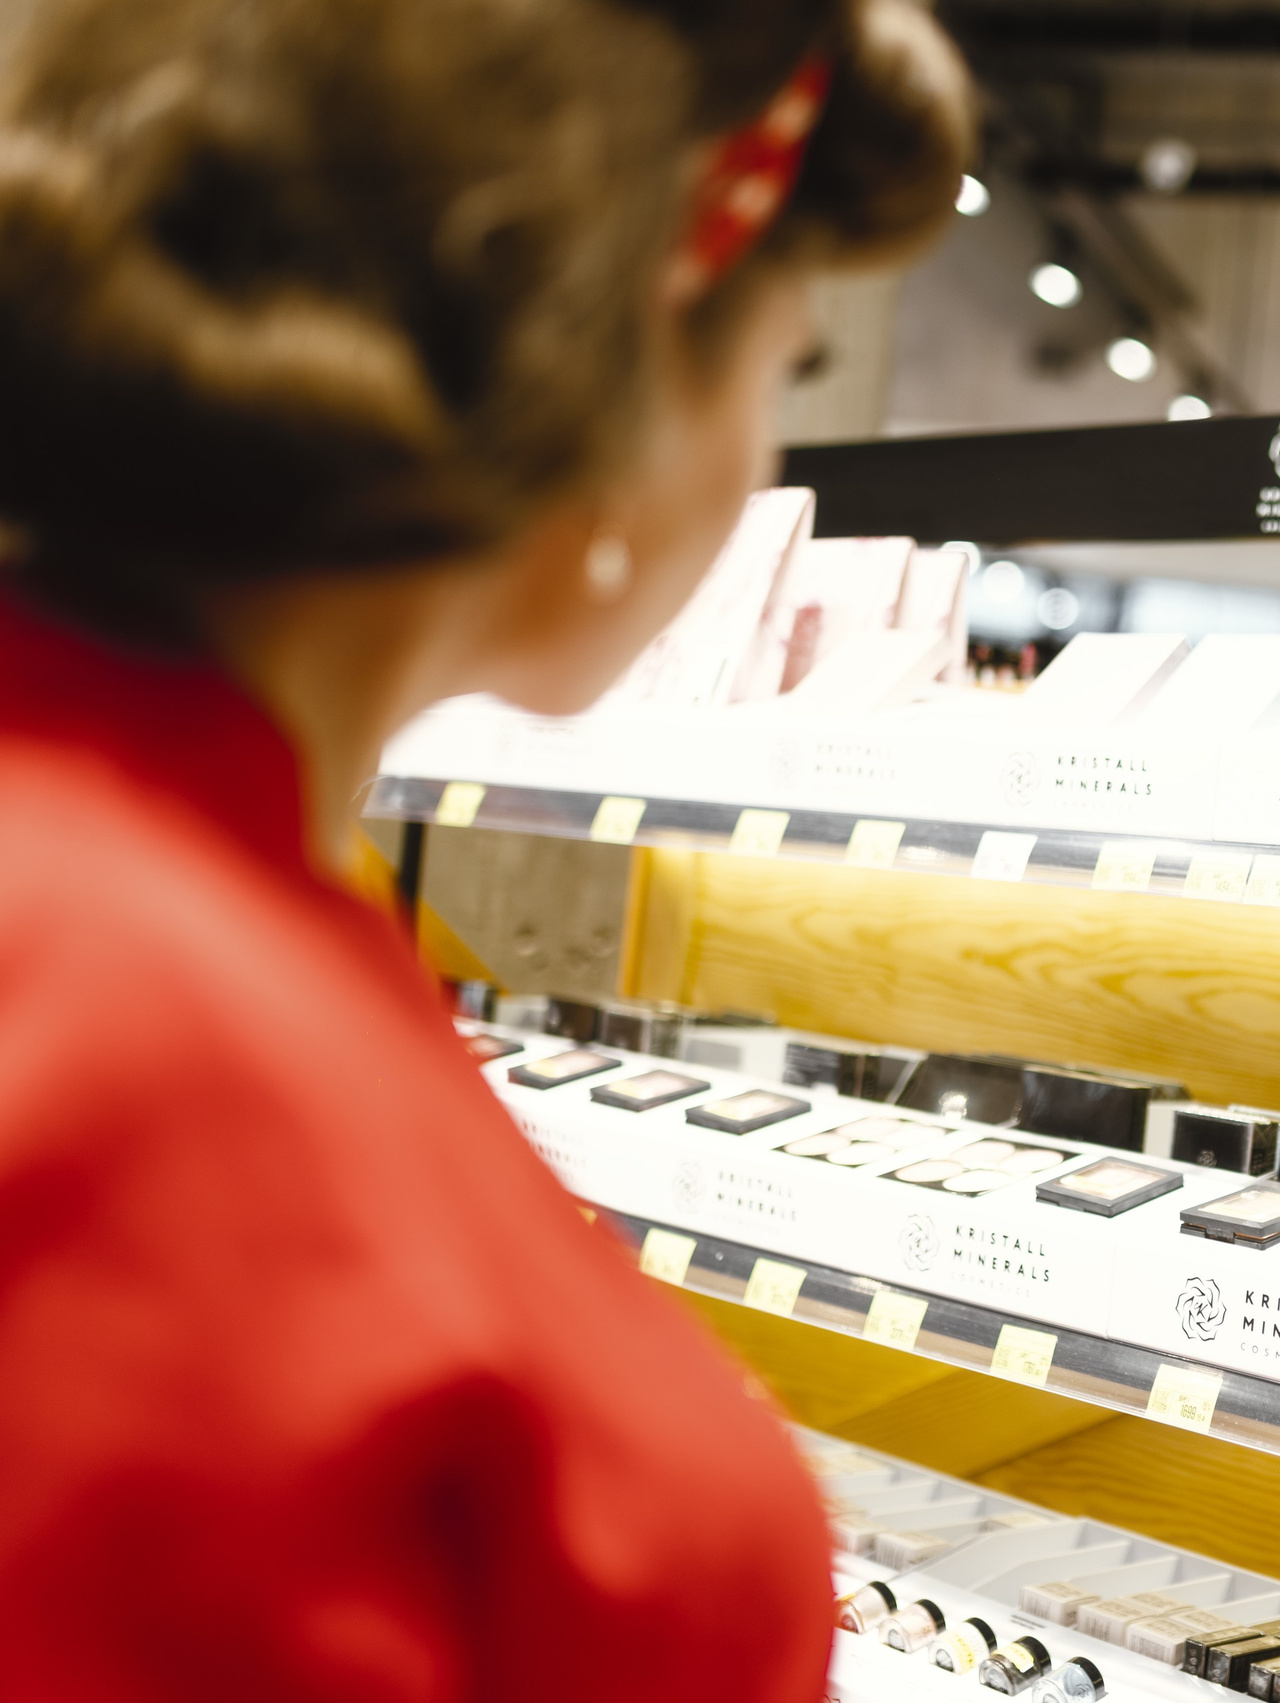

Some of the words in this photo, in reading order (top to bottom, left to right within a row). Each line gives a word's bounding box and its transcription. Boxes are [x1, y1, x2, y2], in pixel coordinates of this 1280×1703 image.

[1057, 755, 1147, 773] KRISTALL
[1056, 779, 1152, 796] MINERALS
[955, 1224, 1046, 1257] KRISTALL
[953, 1248, 1050, 1283] MINERALS
